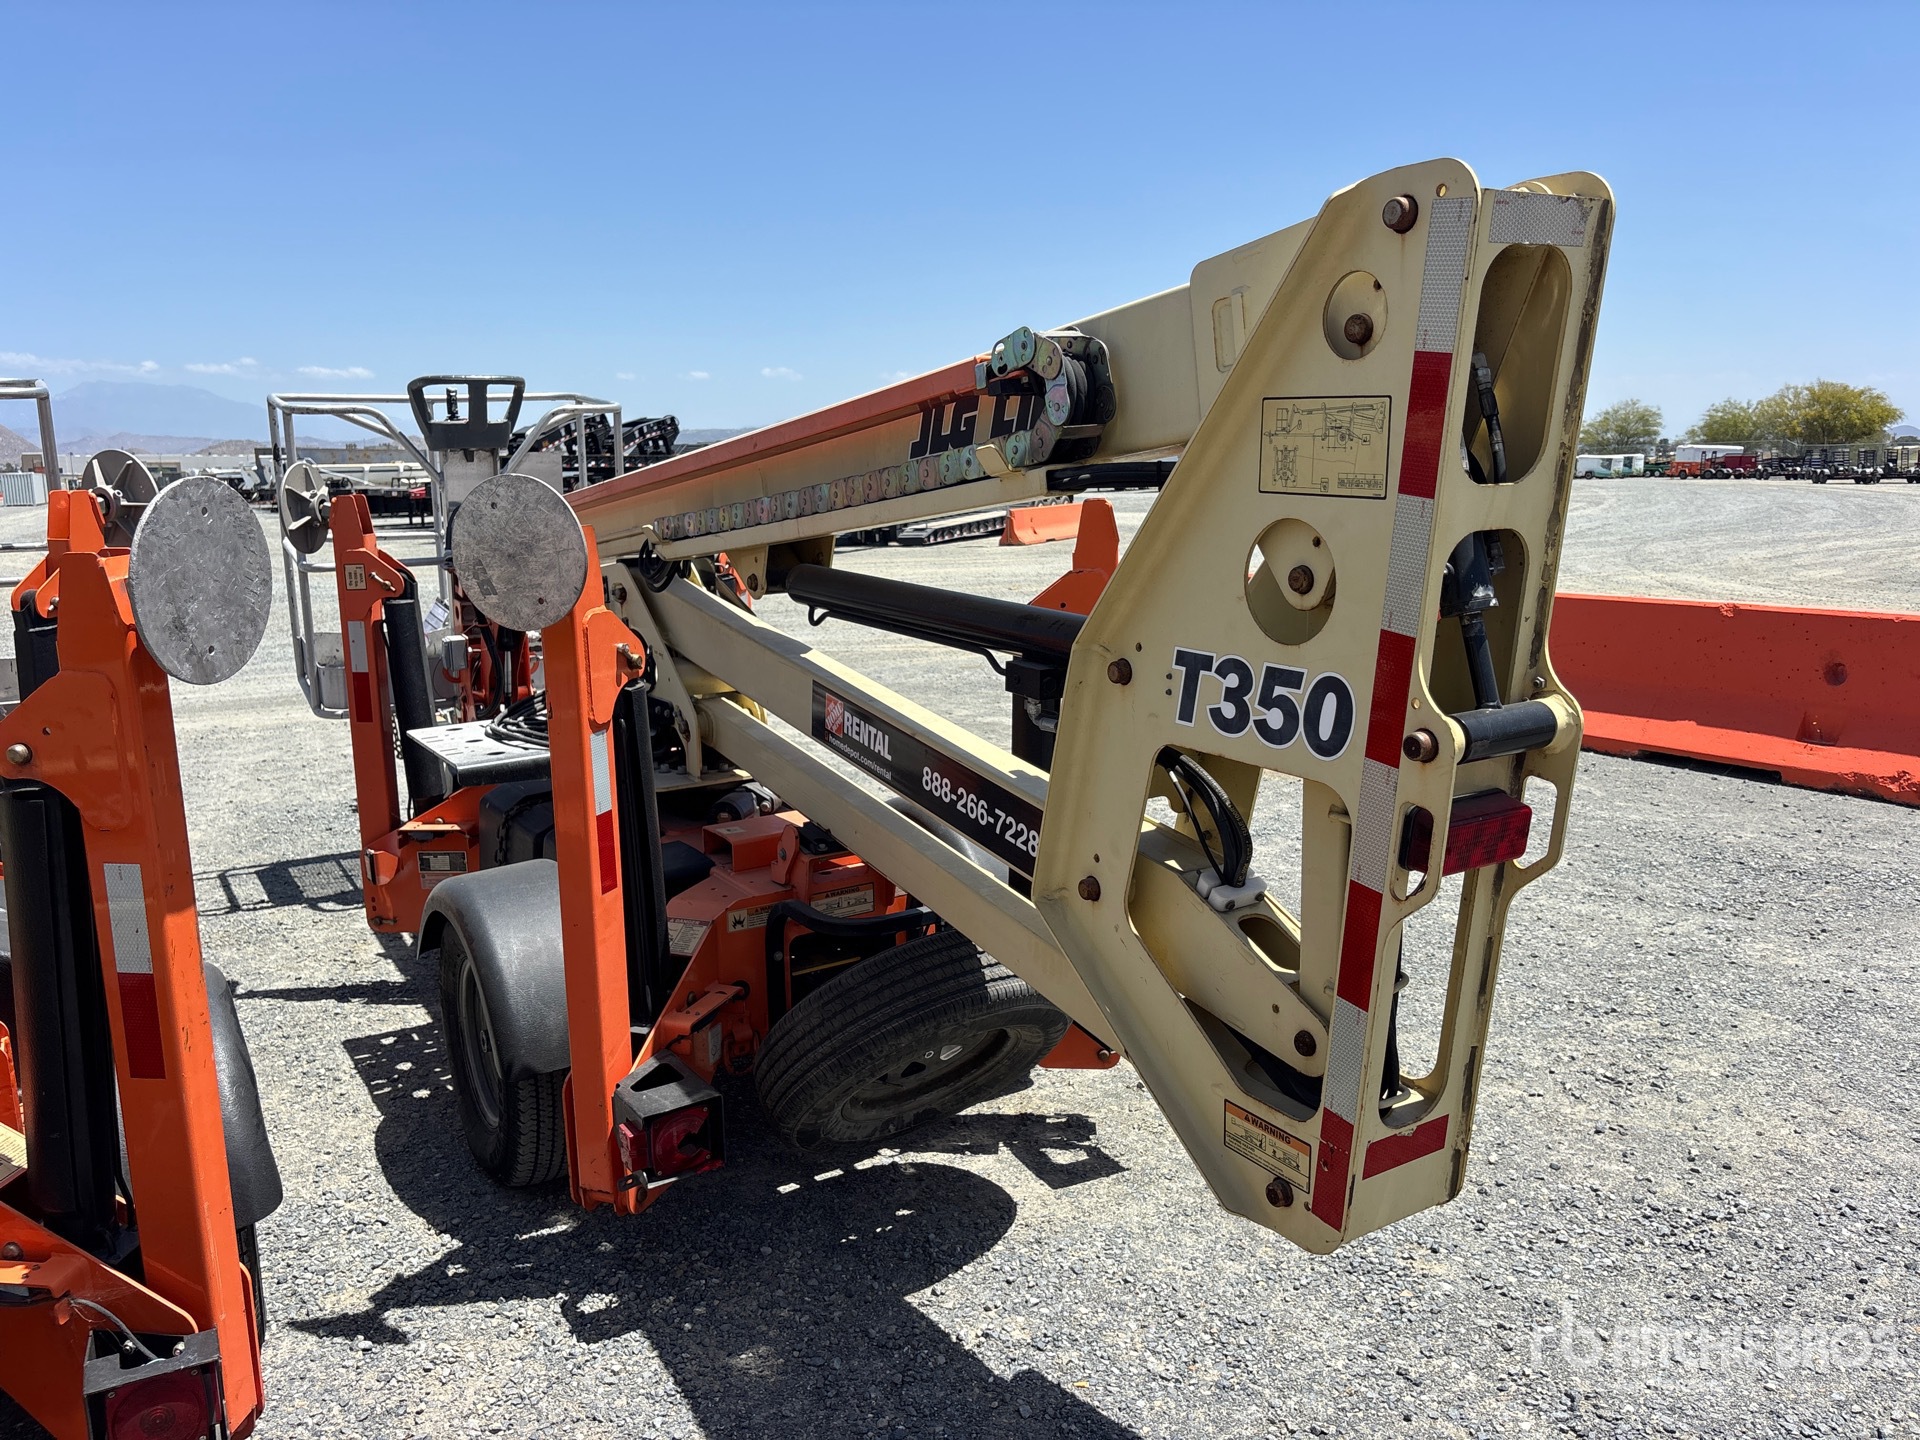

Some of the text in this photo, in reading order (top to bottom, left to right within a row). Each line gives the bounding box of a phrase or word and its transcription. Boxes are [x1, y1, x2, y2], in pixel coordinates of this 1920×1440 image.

[909, 395, 979, 460] JLG
[826, 701, 844, 729] HOME
[1172, 647, 1355, 761] T350
[829, 734, 892, 781] homedepot.com/rental
[844, 710, 892, 762] RENTAL
[921, 766, 1039, 858] 888-266-7228
[830, 887, 860, 897] WARNING
[1250, 1117, 1291, 1145] WARNING
